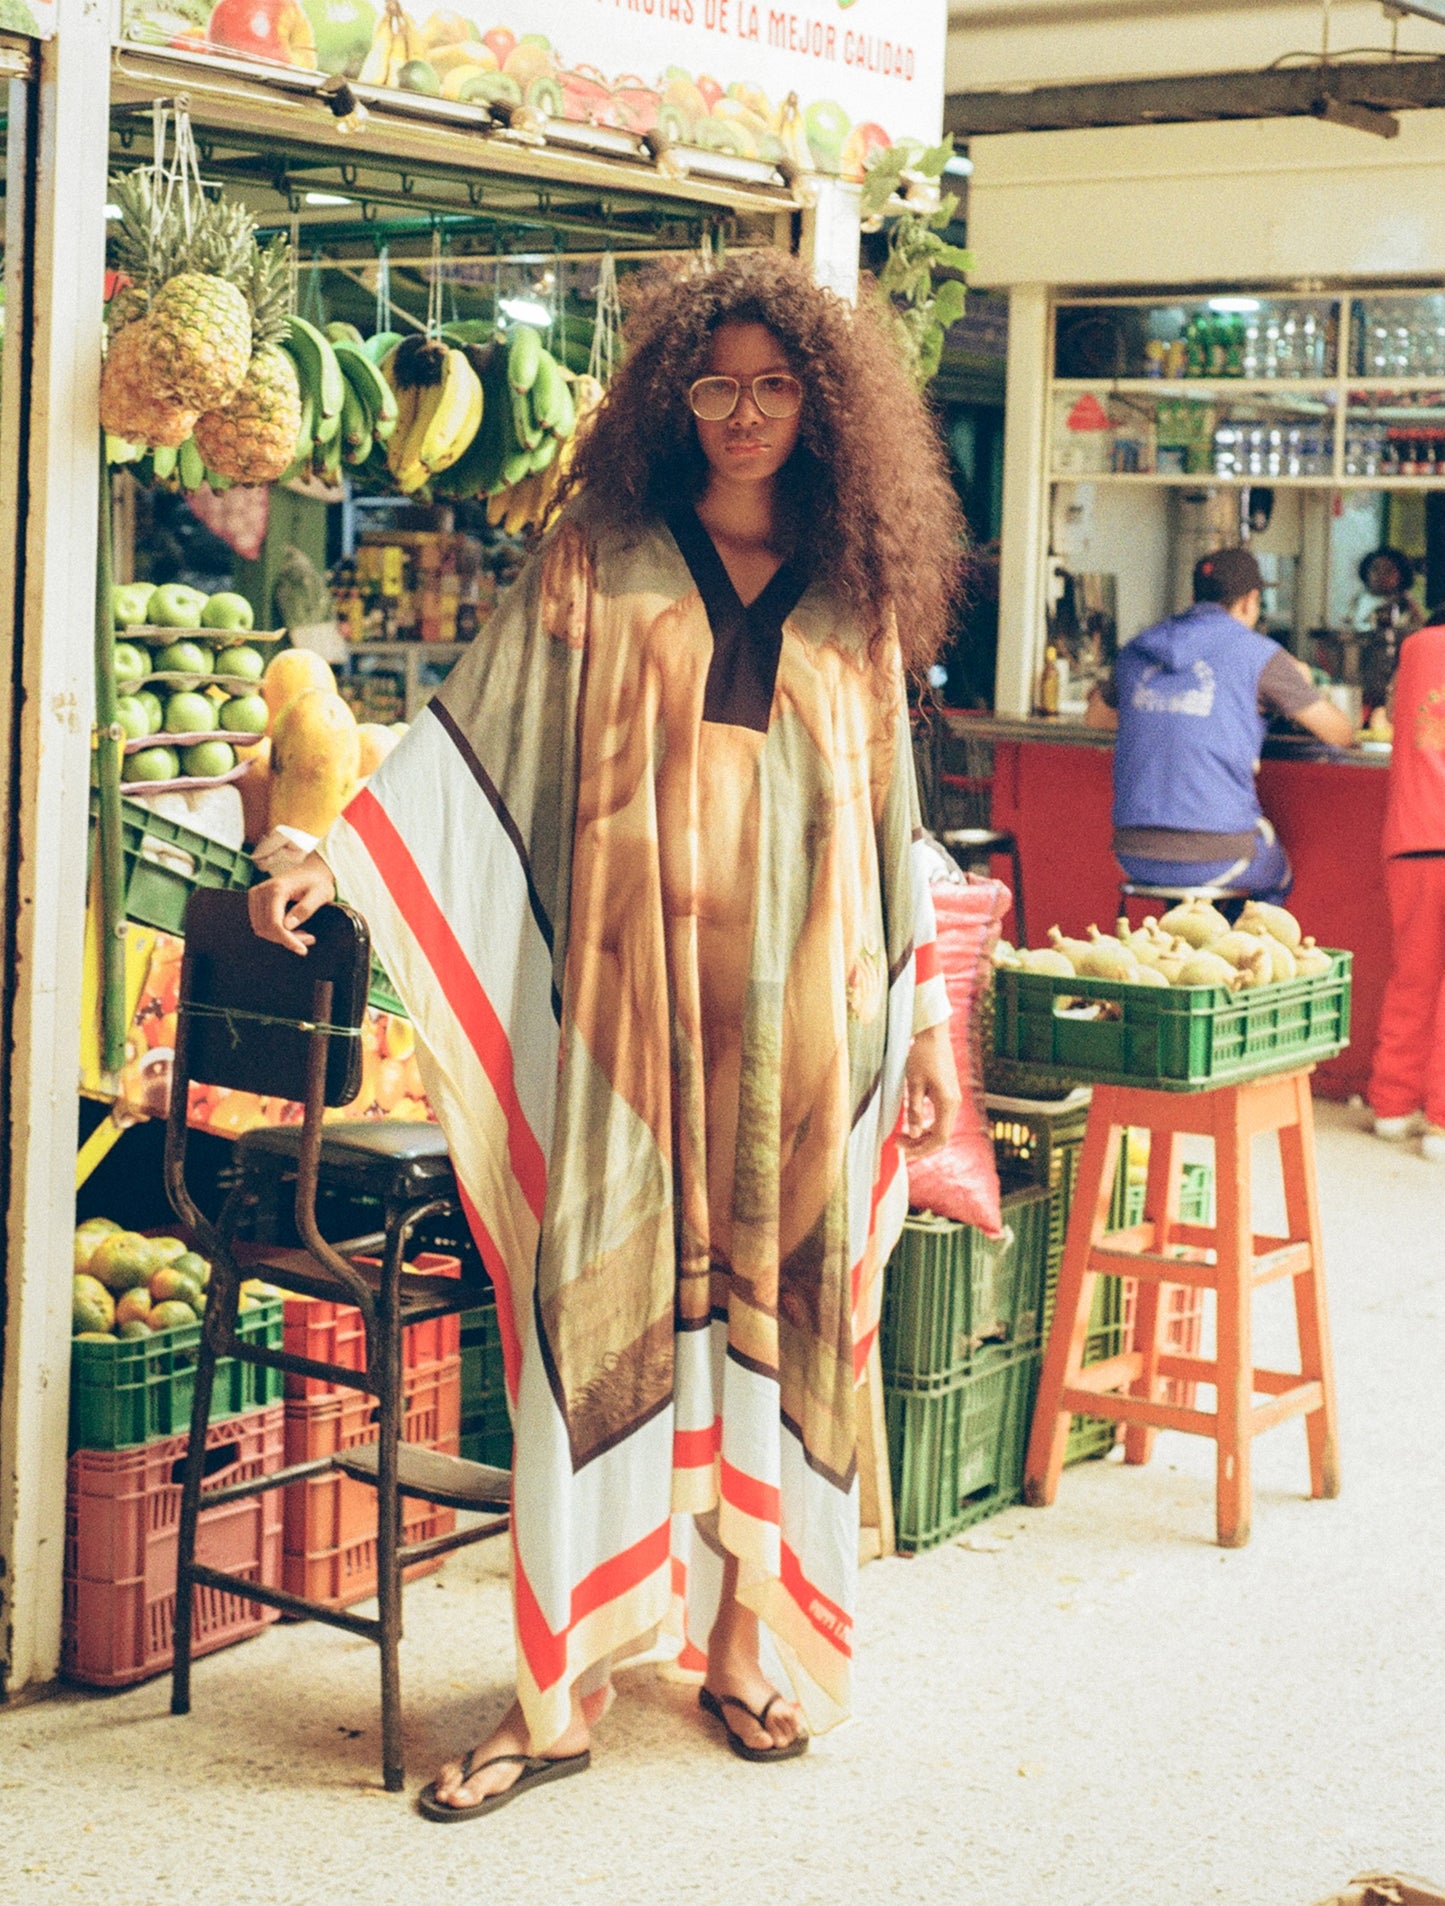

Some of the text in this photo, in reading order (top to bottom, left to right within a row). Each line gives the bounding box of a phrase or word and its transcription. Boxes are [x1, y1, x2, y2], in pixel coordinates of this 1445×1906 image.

[705, 0, 727, 34] DE
[738, 0, 759, 42] LA
[768, 9, 836, 61] MEJOR
[843, 29, 915, 82] CALIDAD
